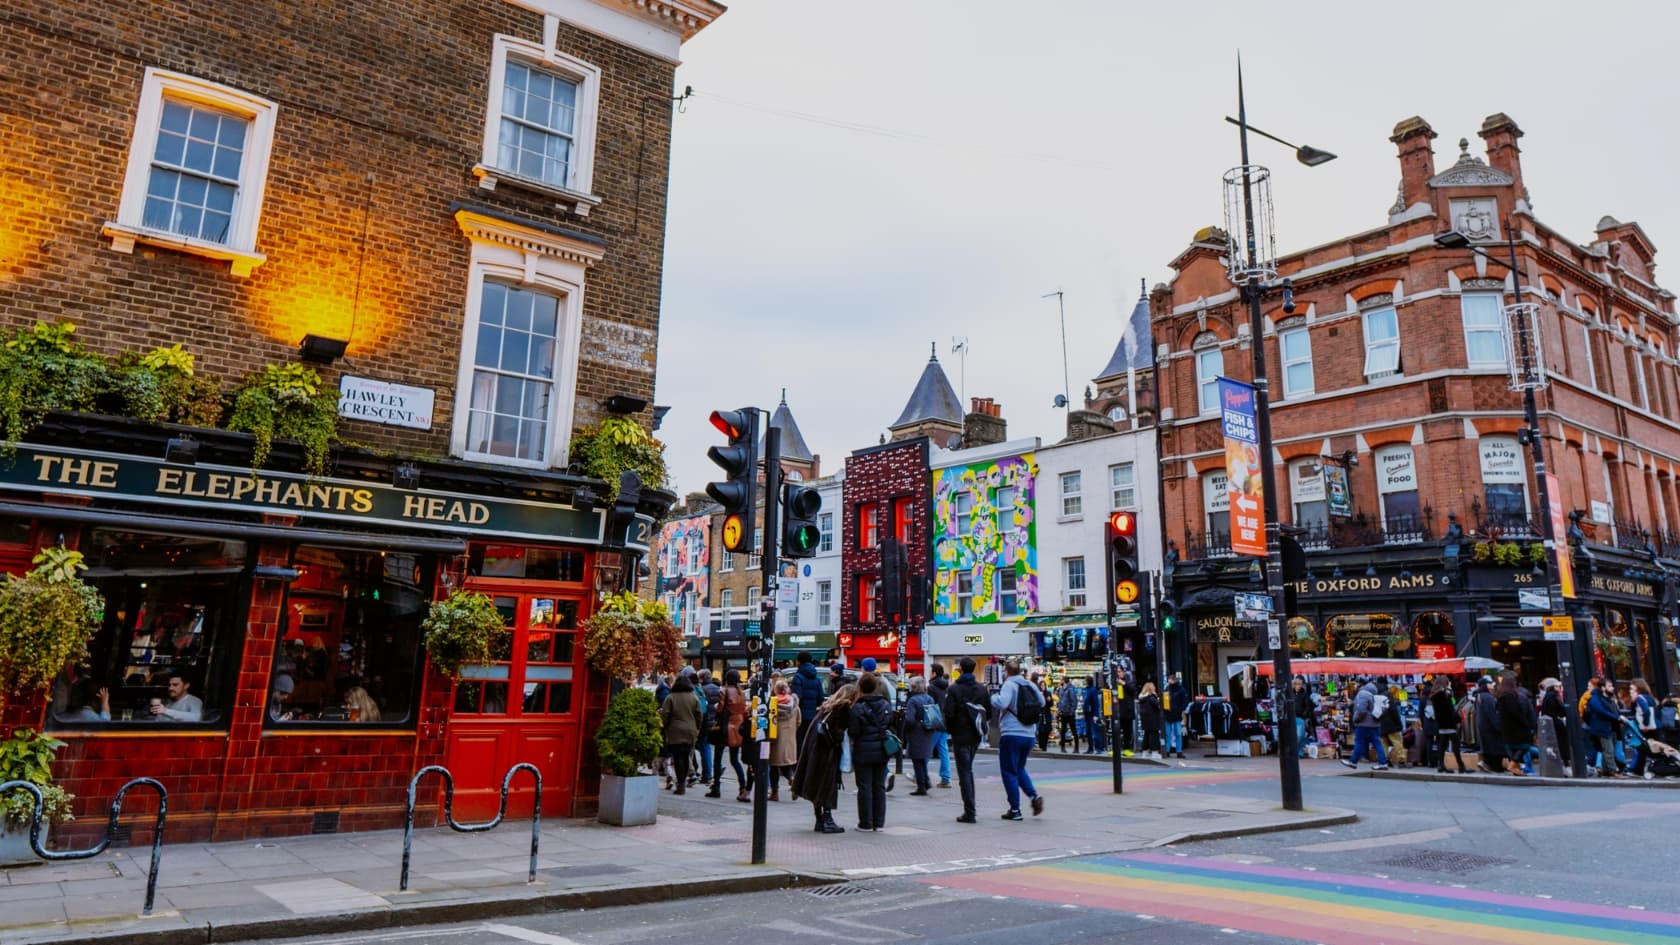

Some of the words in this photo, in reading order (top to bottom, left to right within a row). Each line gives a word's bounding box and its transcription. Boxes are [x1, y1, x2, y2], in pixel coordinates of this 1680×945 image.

[346, 388, 406, 408] HAWLEY
[342, 401, 414, 422] CRESCENT
[1224, 411, 1246, 427] FISH
[1246, 418, 1255, 429] &
[1225, 423, 1256, 440] CHIPS
[1383, 452, 1411, 463] FRESHLY
[1484, 450, 1516, 459] MAJOR
[1387, 475, 1411, 485] FOOD
[33, 454, 119, 488] THE
[155, 468, 374, 513] ELEPHANTS
[402, 495, 490, 525] HEAD
[1316, 577, 1382, 592] OXFORD
[1389, 574, 1435, 589] ARMS
[1513, 573, 1533, 583] 265
[1606, 579, 1635, 594] OXFORD
[1636, 583, 1654, 597] ARMS
[1198, 616, 1233, 630] SALOON
